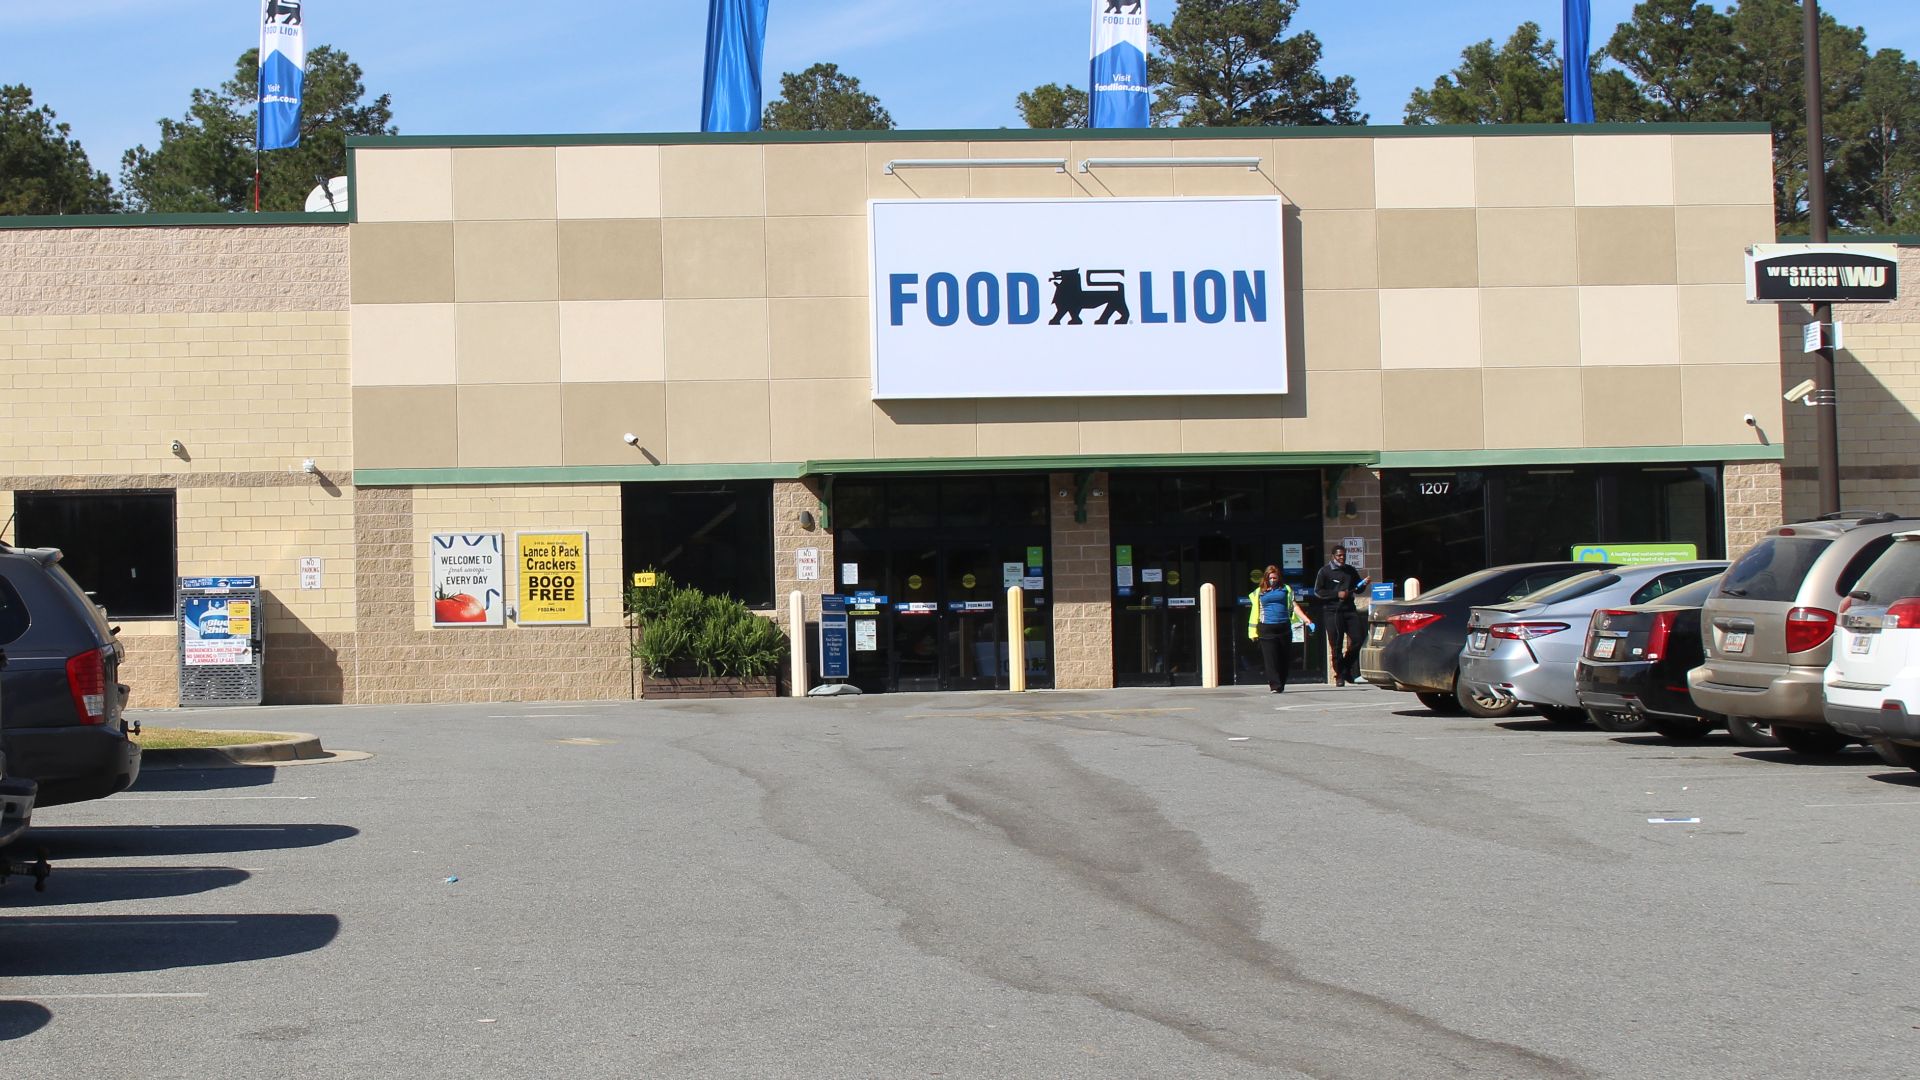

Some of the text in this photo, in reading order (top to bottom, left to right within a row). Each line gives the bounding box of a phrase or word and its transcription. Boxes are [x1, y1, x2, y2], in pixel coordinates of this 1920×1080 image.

[1103, 16, 1124, 25] FOOD
[280, 26, 298, 36] LION
[1112, 74, 1131, 82] Visit
[1094, 83, 1148, 93] foodlion.com
[1767, 266, 1838, 277] WESTERN
[1789, 276, 1838, 287] UNION
[889, 269, 1267, 326] FOOD LION
[1420, 482, 1450, 495] 1207
[523, 545, 580, 557] Lance 8 Pack
[441, 555, 493, 565] WELCOME TO
[526, 558, 576, 570] Crackers
[446, 576, 488, 585] EVERY DAY
[528, 576, 575, 588] BOGO
[529, 588, 575, 601] FREE
